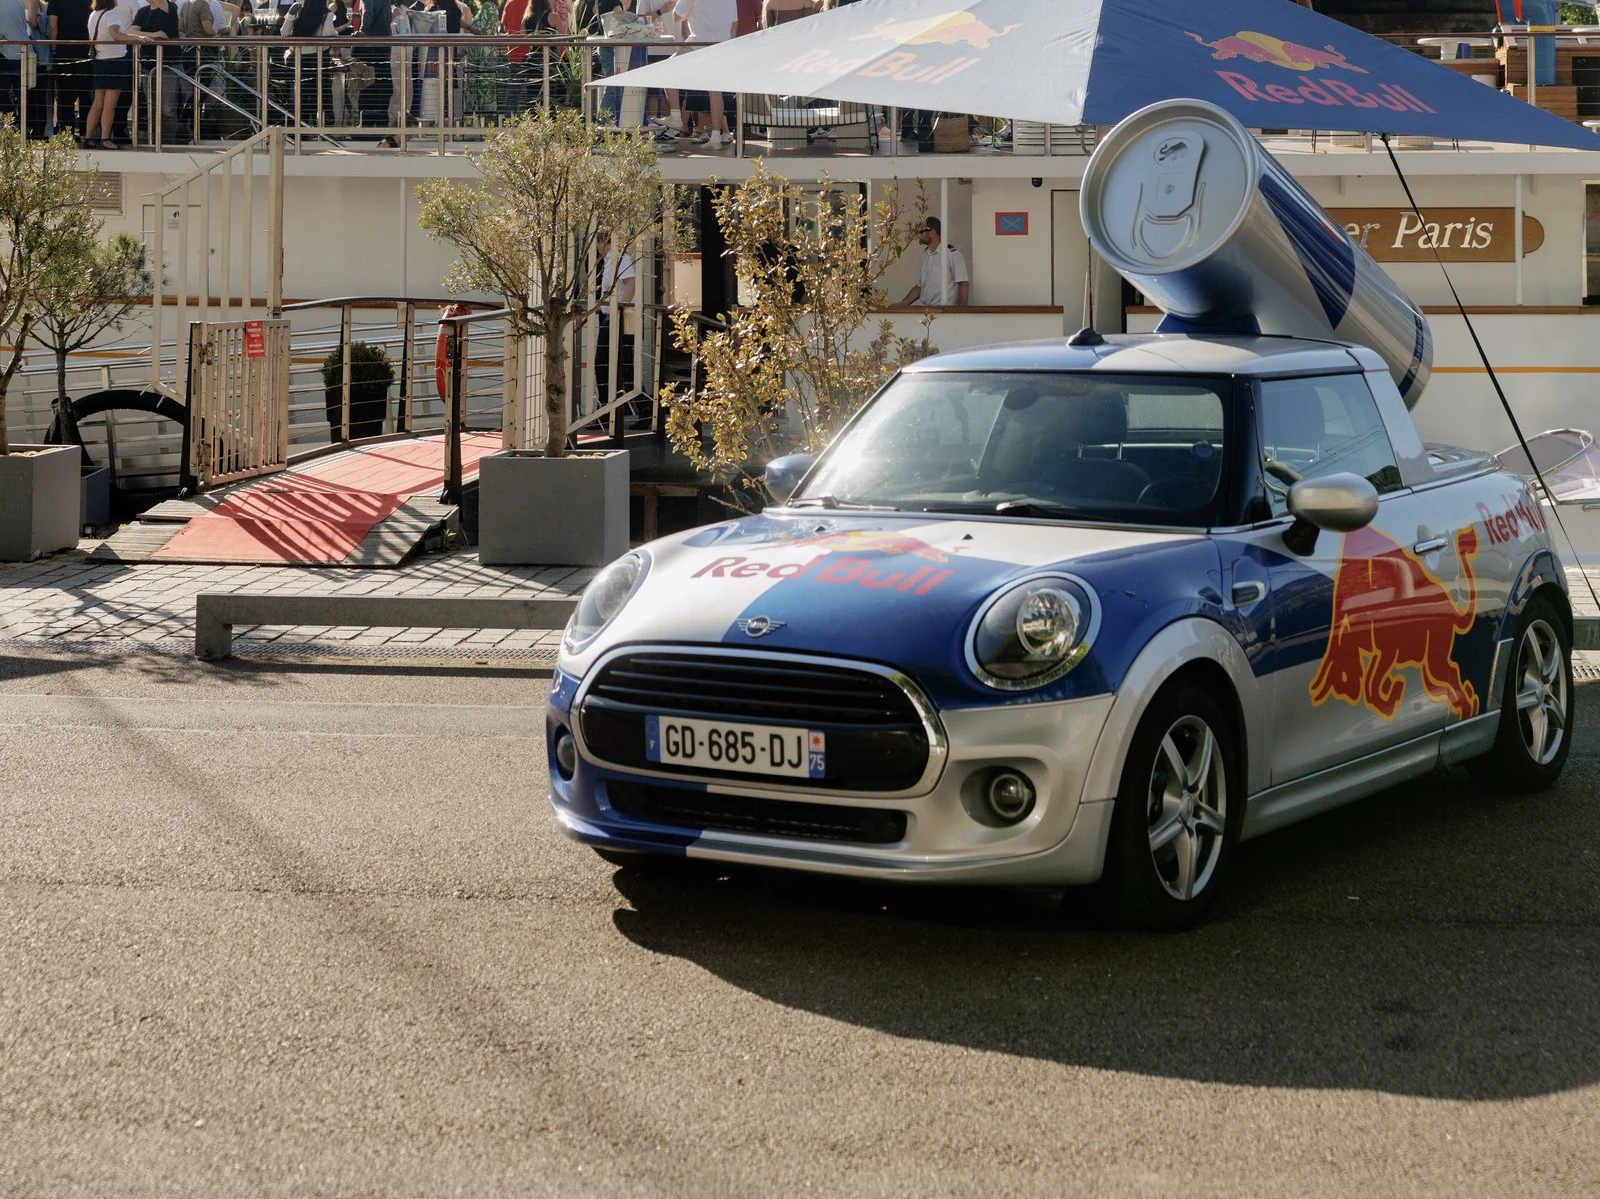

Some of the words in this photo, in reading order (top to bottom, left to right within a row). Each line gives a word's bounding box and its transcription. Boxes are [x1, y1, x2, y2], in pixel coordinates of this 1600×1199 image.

[855, 51, 983, 84] Bull
[1213, 70, 1344, 106] Red
[1319, 78, 1437, 114] Bull
[1391, 211, 1494, 249] Paris
[690, 554, 828, 580] Red
[813, 557, 953, 596] Bull
[650, 740, 656, 750] F
[665, 724, 802, 769] GD-685-DJ
[809, 754, 825, 771] 75
